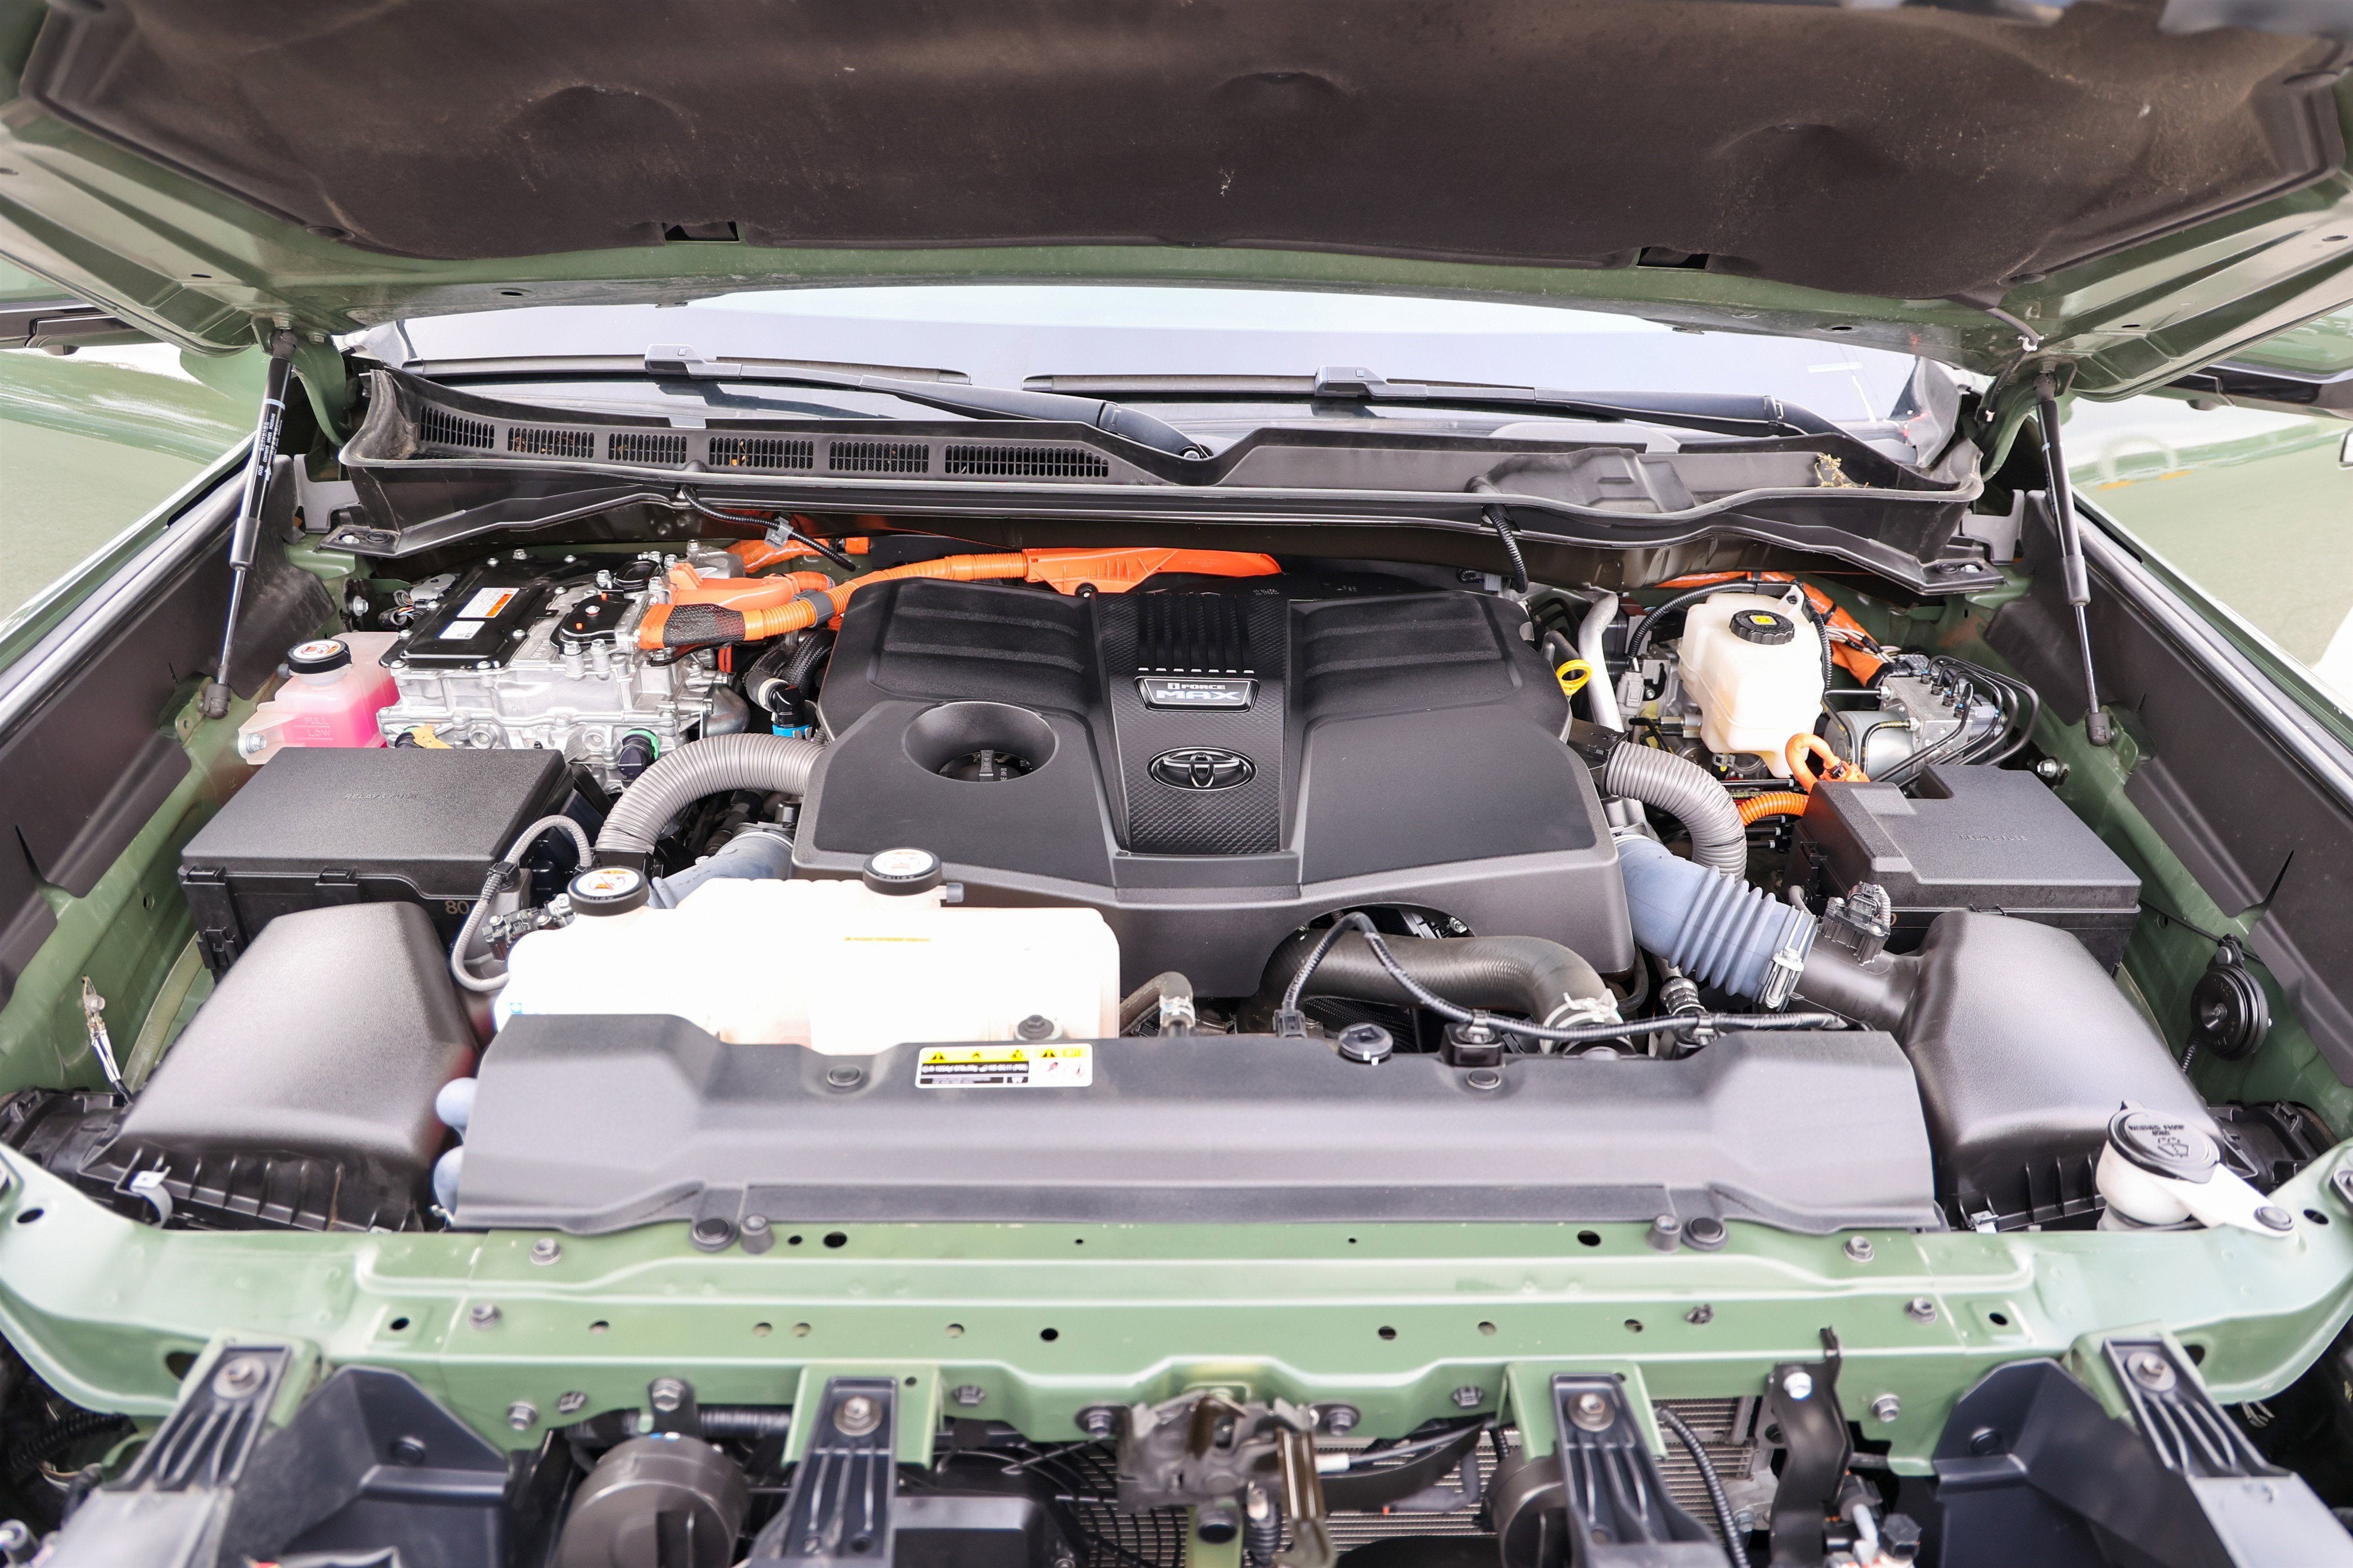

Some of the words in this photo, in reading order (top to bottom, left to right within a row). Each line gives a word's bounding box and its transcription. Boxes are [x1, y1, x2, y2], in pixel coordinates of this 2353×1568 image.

[1156, 690, 1241, 700] MAX
[304, 717, 330, 725] FULL
[445, 901, 470, 915] 80
